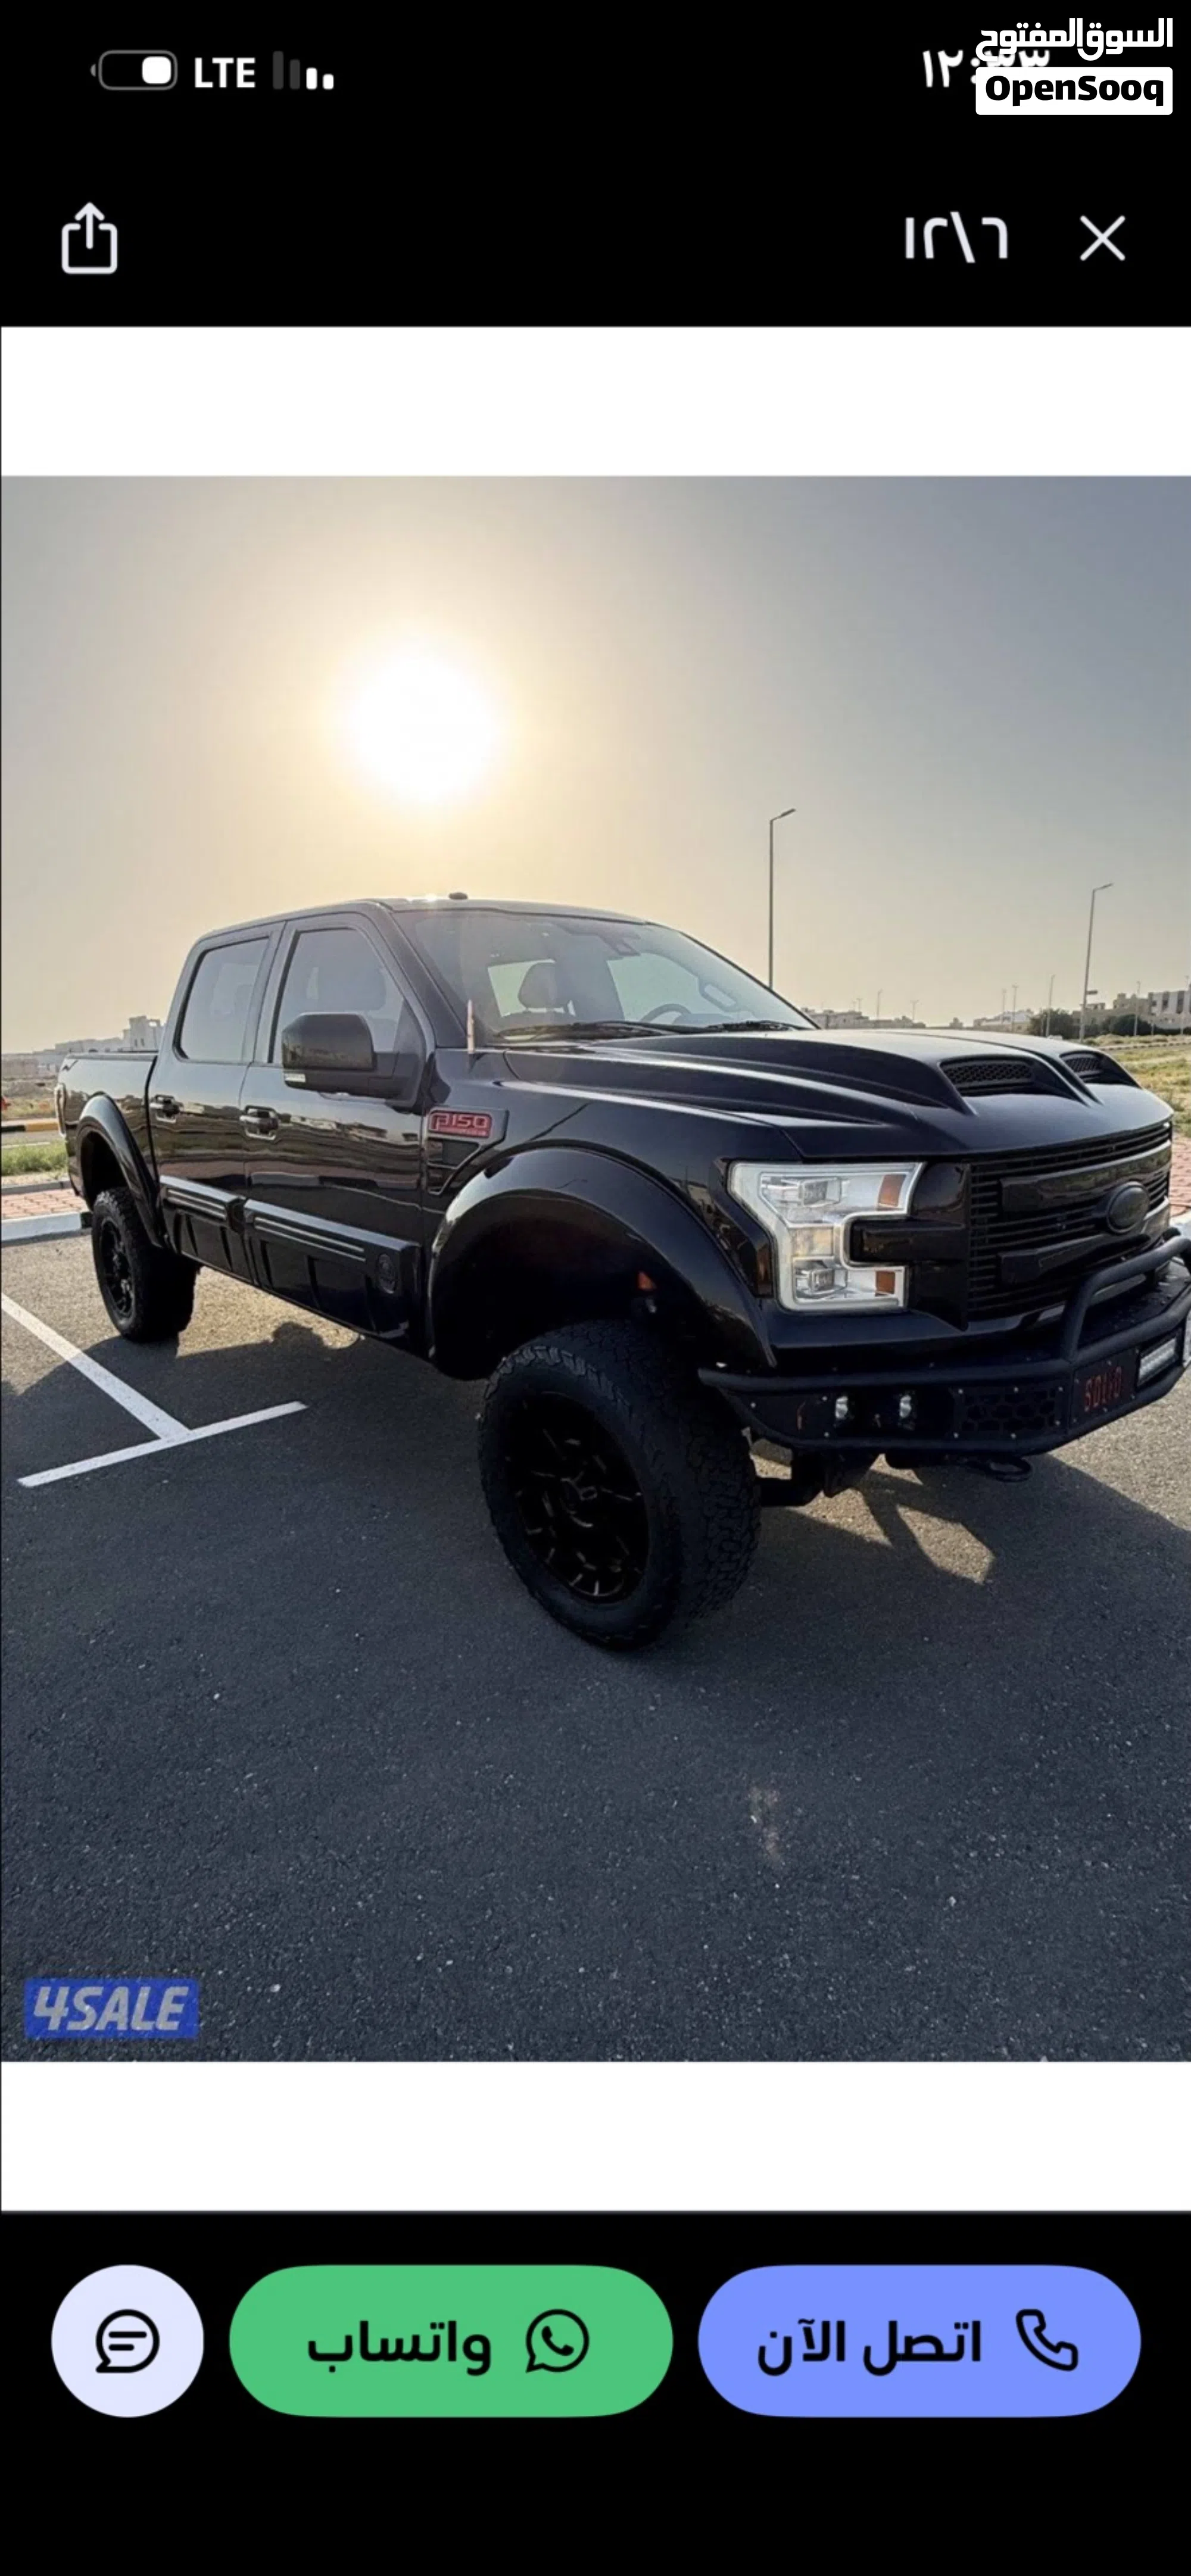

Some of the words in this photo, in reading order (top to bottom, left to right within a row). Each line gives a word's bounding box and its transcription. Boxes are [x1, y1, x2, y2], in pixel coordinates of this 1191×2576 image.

[195, 57, 255, 88] LTE
[308, 2321, 491, 2376] واتساب
[758, 2318, 845, 2377] الآن
[863, 2321, 981, 2377] اتصل
